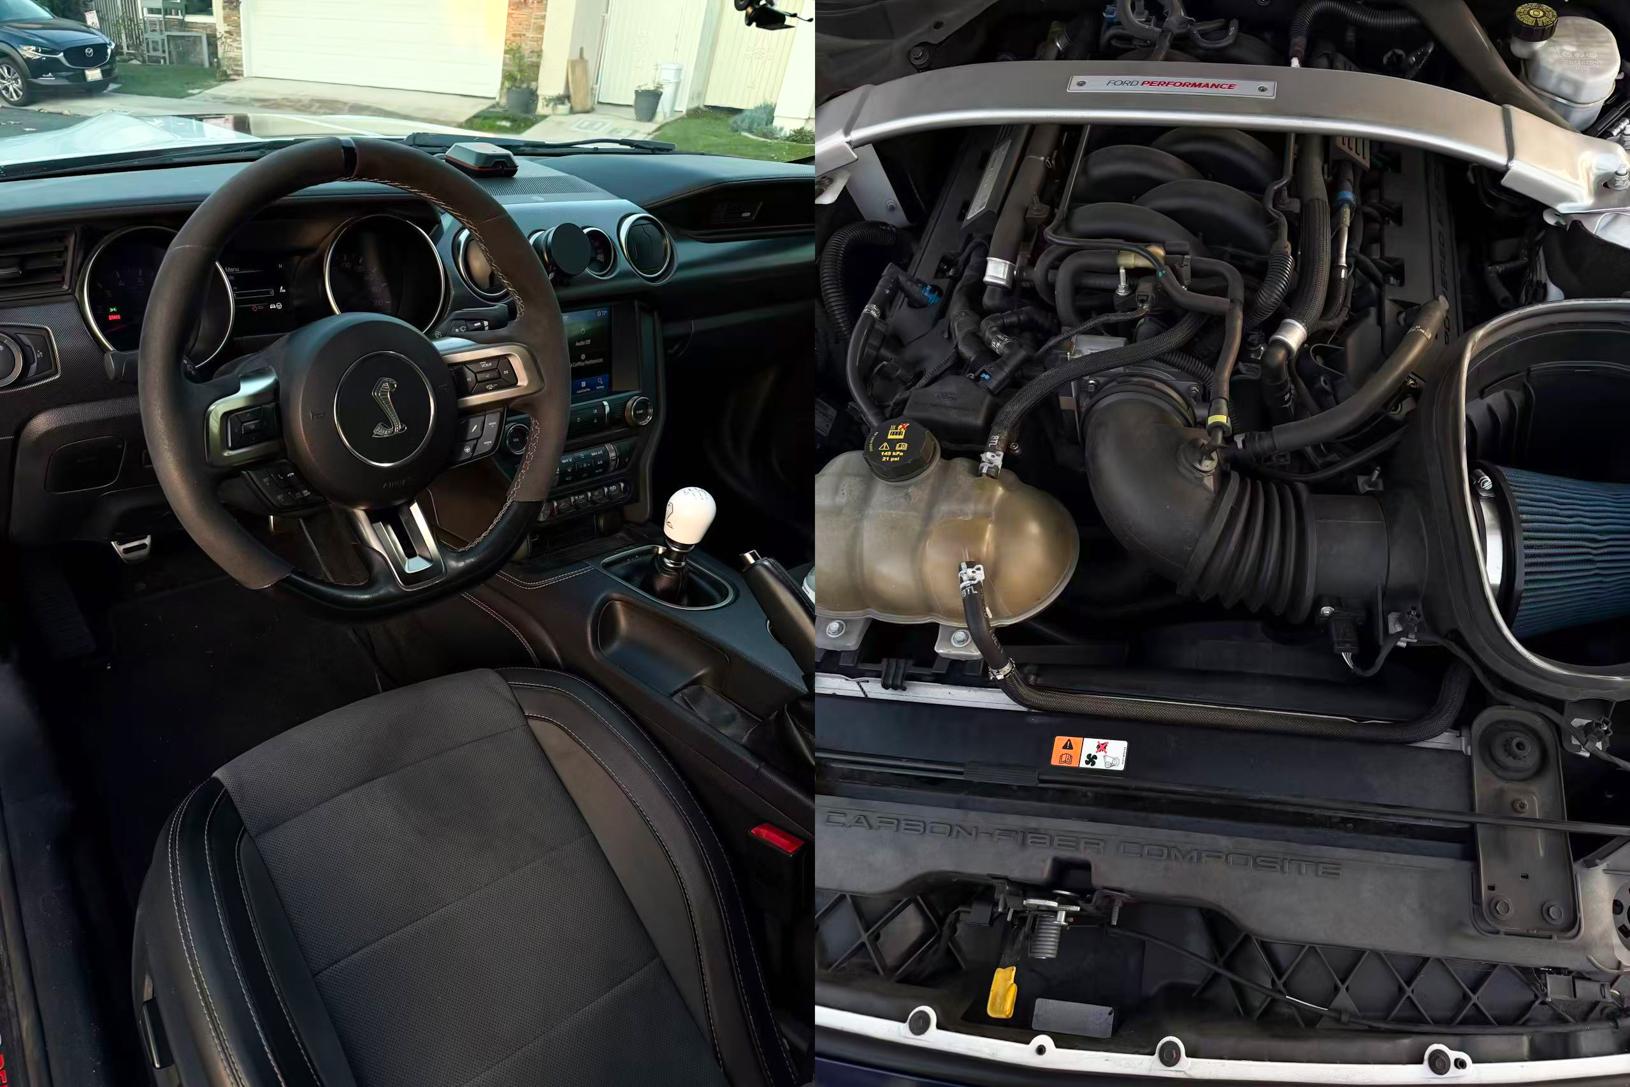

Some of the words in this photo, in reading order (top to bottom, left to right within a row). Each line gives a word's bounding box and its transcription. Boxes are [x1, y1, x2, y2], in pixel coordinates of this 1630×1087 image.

[1106, 79, 1139, 87] FORD
[1140, 80, 1237, 90] PERFORMANCE
[1118, 841, 1343, 880] COMPOSITE
